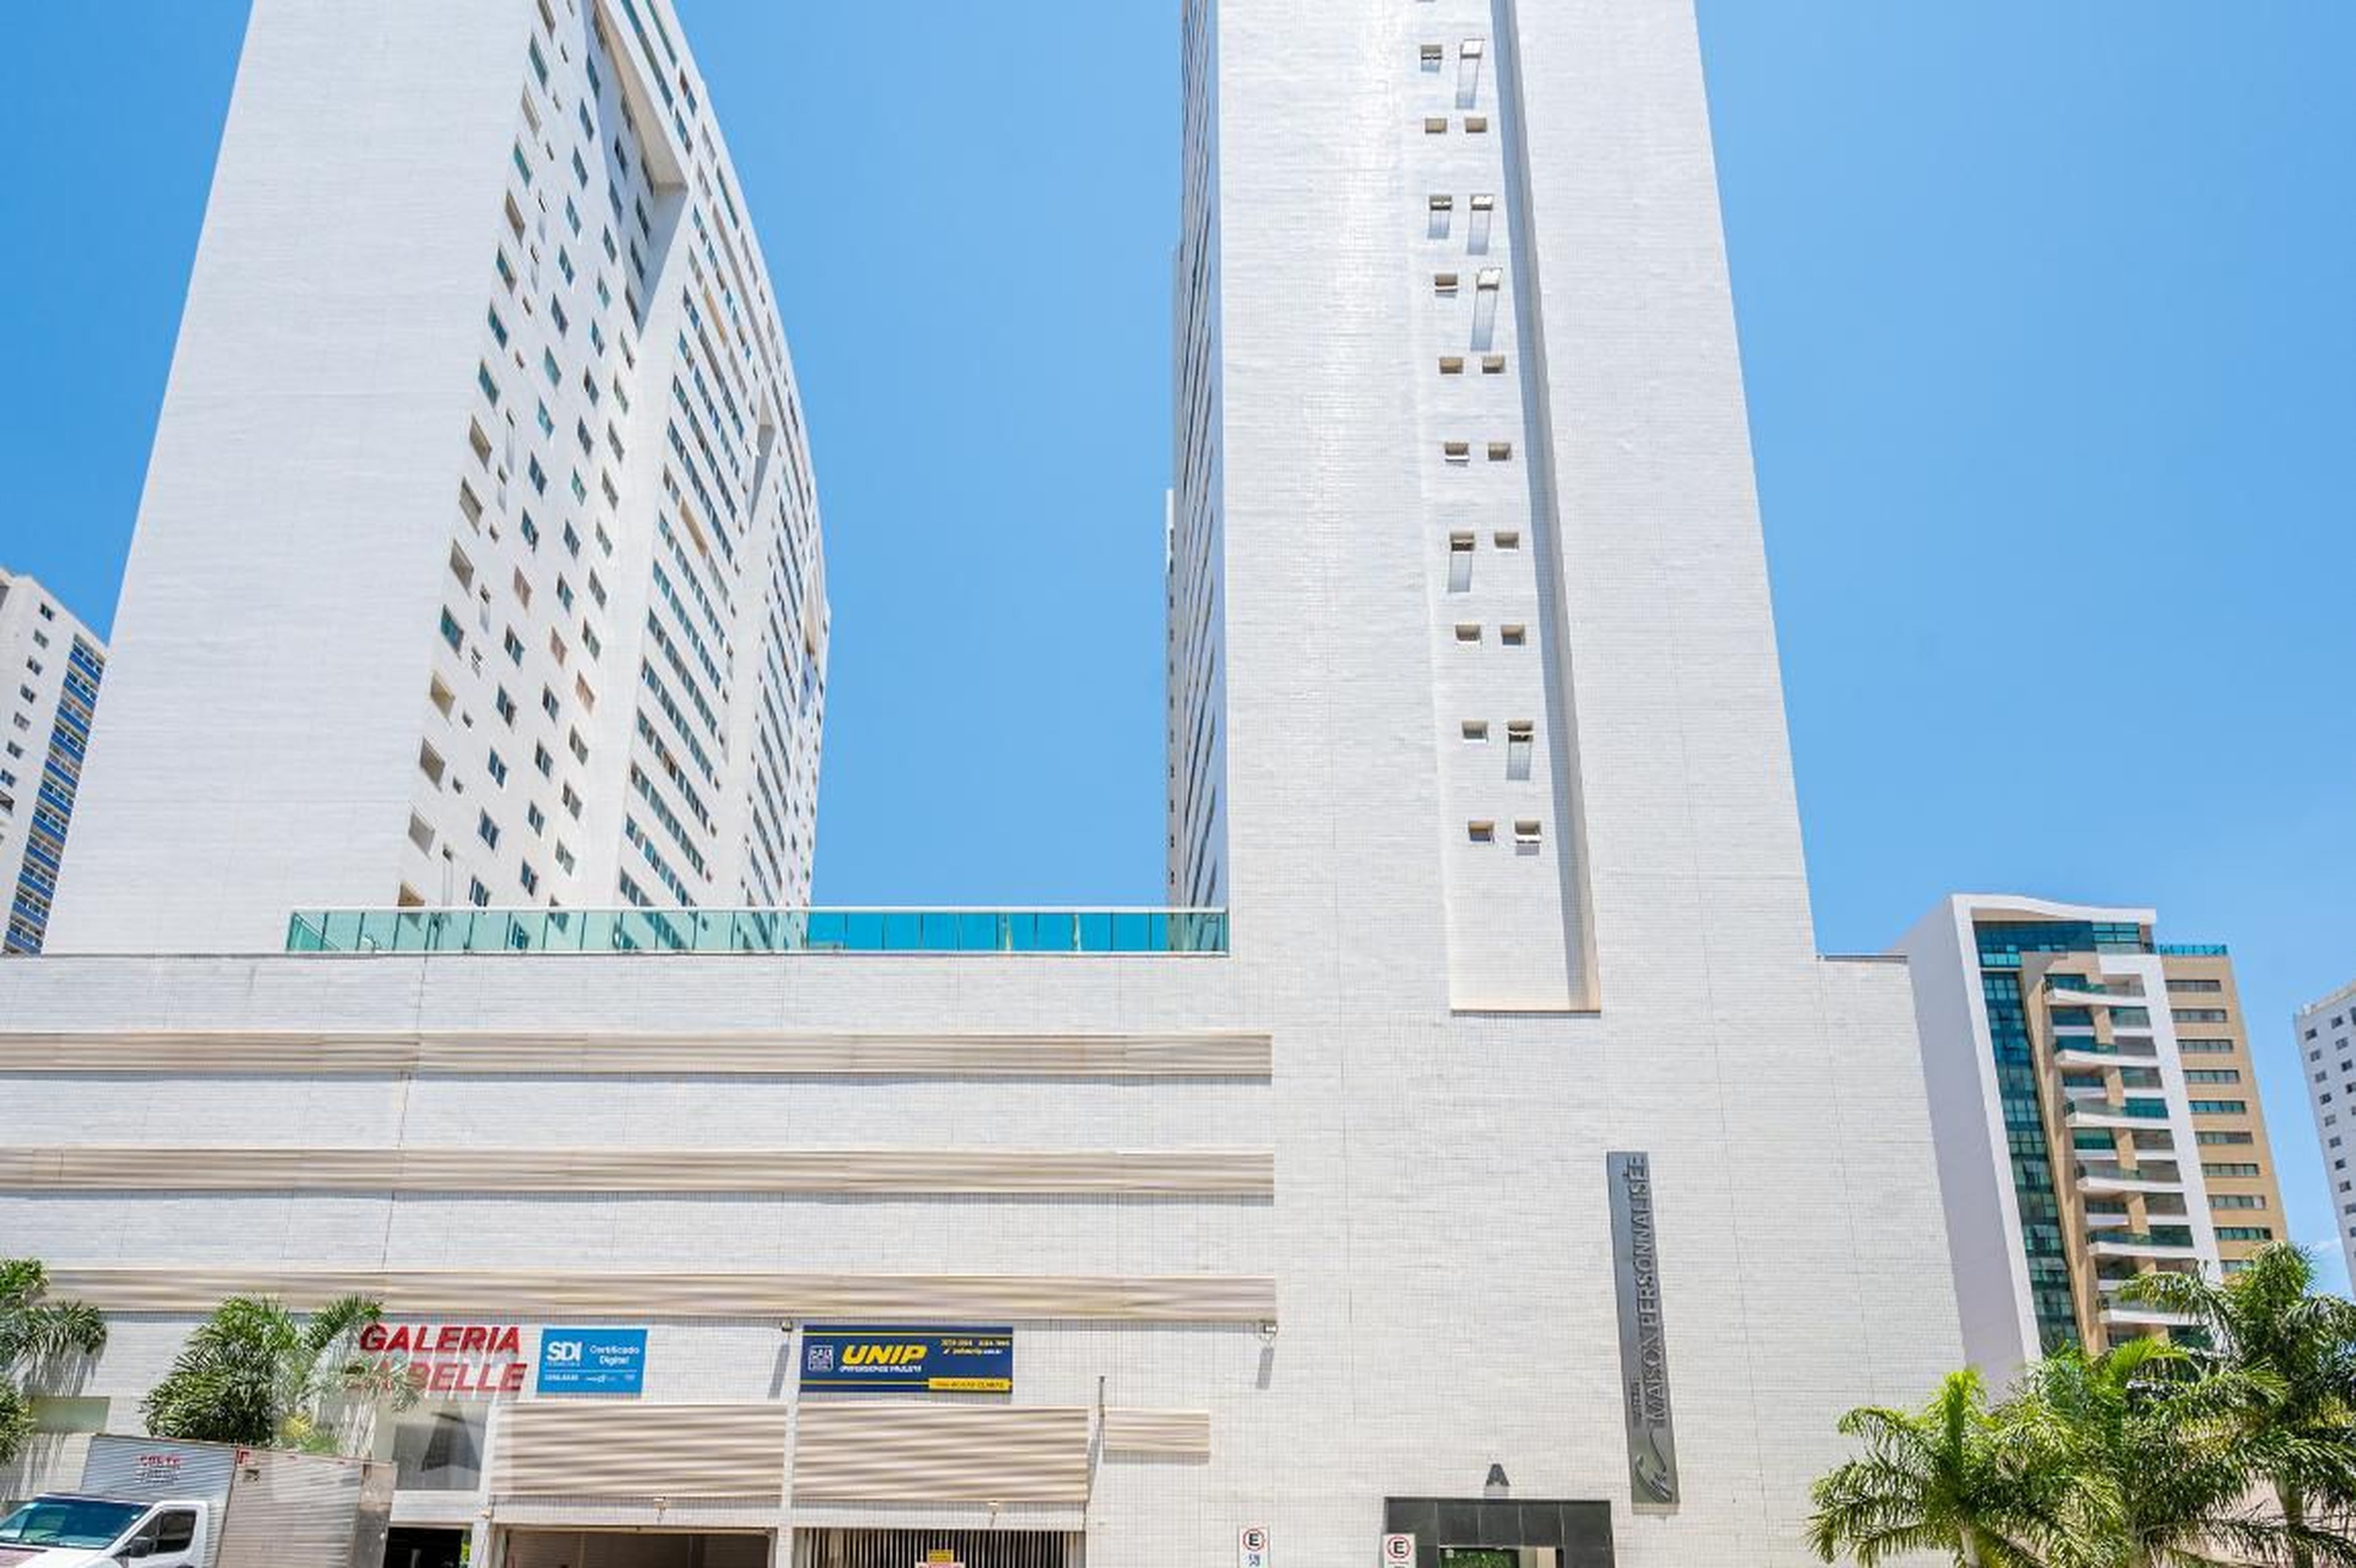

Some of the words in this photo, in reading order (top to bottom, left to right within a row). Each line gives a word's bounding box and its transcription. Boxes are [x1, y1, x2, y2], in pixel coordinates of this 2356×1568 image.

[360, 1325, 520, 1351] GALERIA
[545, 1341, 583, 1361] SDI
[589, 1344, 641, 1355] Certificado
[841, 1345, 928, 1365] UNIP
[599, 1355, 630, 1366] Digital
[1640, 1338, 1666, 1420] MAISON
[1485, 1463, 1511, 1487] A
[1249, 1533, 1260, 1547] E
[1393, 1541, 1405, 1554] E
